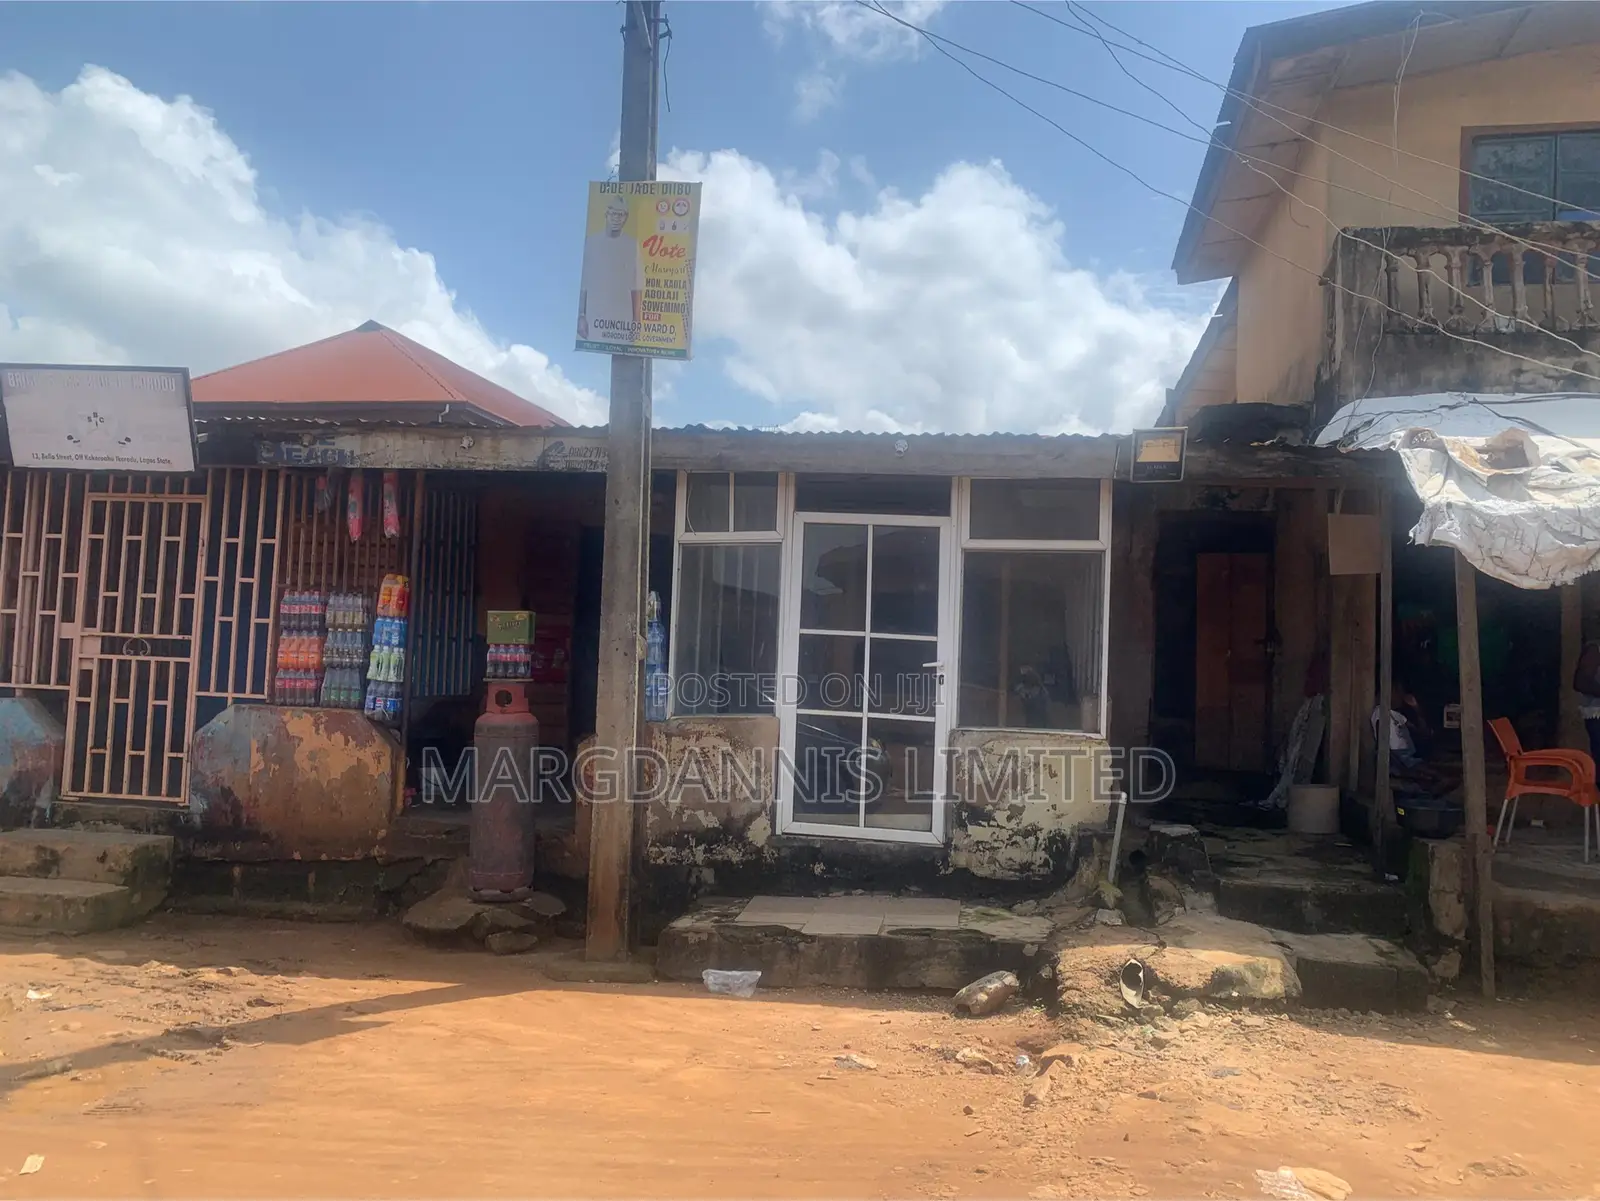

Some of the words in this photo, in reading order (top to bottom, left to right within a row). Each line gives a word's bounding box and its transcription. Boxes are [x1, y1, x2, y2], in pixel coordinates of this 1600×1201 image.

[629, 182, 657, 195] JADE
[642, 234, 686, 258] Vote
[644, 289, 679, 301] ABOLAJI
[642, 300, 686, 314] SOWEMIMO
[644, 313, 660, 321] FOR
[594, 318, 642, 332] COUNCILLOR
[643, 322, 667, 334] WARD
[642, 335, 676, 344] GOVERNMENT
